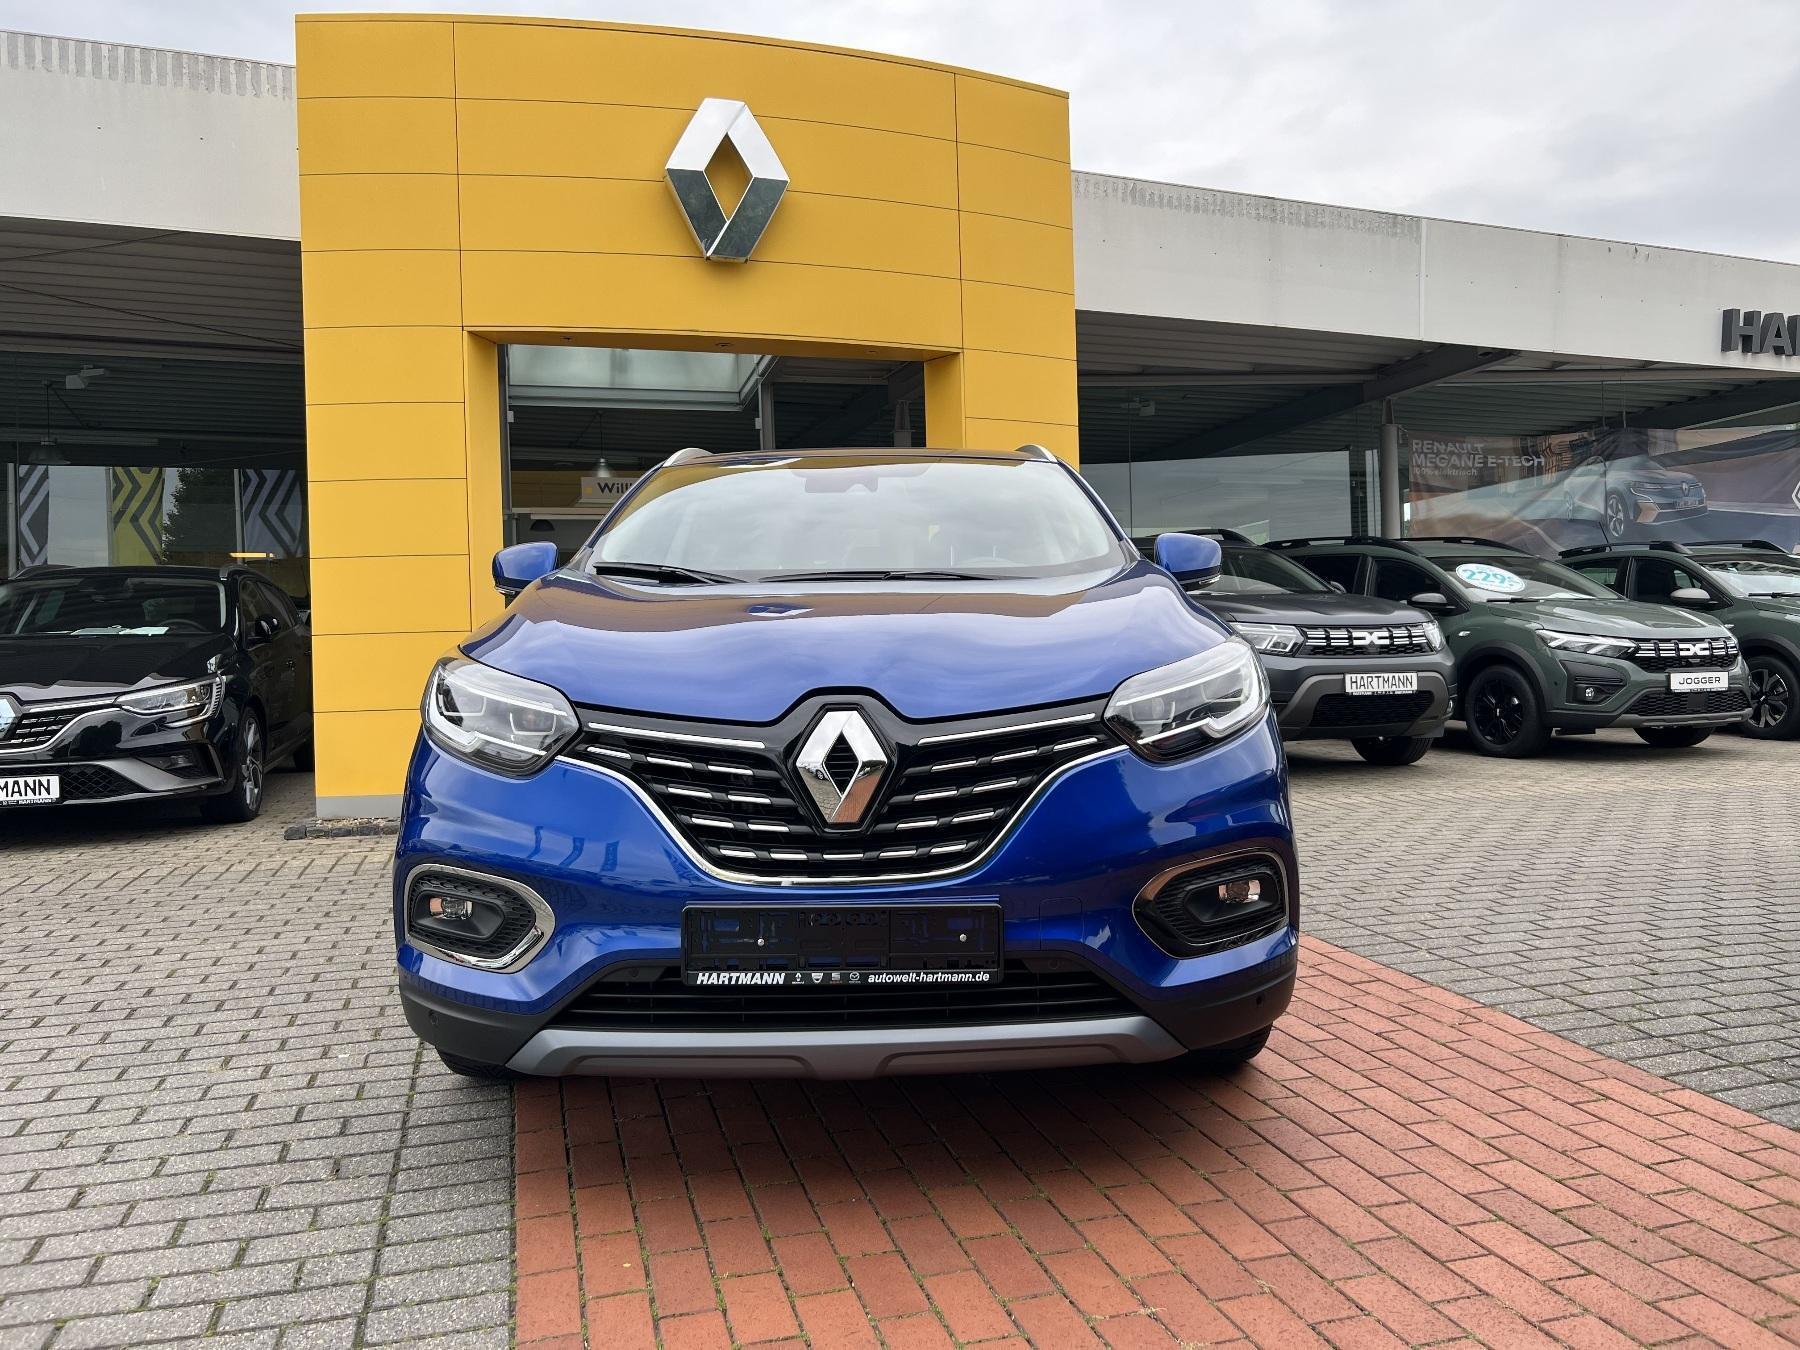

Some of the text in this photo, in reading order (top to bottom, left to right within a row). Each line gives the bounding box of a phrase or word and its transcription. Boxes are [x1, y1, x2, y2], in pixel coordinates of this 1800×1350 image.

[1721, 309, 1800, 356] HA
[1412, 440, 1484, 454] RENAULT
[1488, 455, 1545, 467] E-TECH
[597, 482, 632, 494] Will
[1350, 675, 1413, 689] HARTMANN
[1679, 676, 1721, 685] JOGGER
[697, 971, 990, 985] HARTMANN autowelt-hartmann.de
